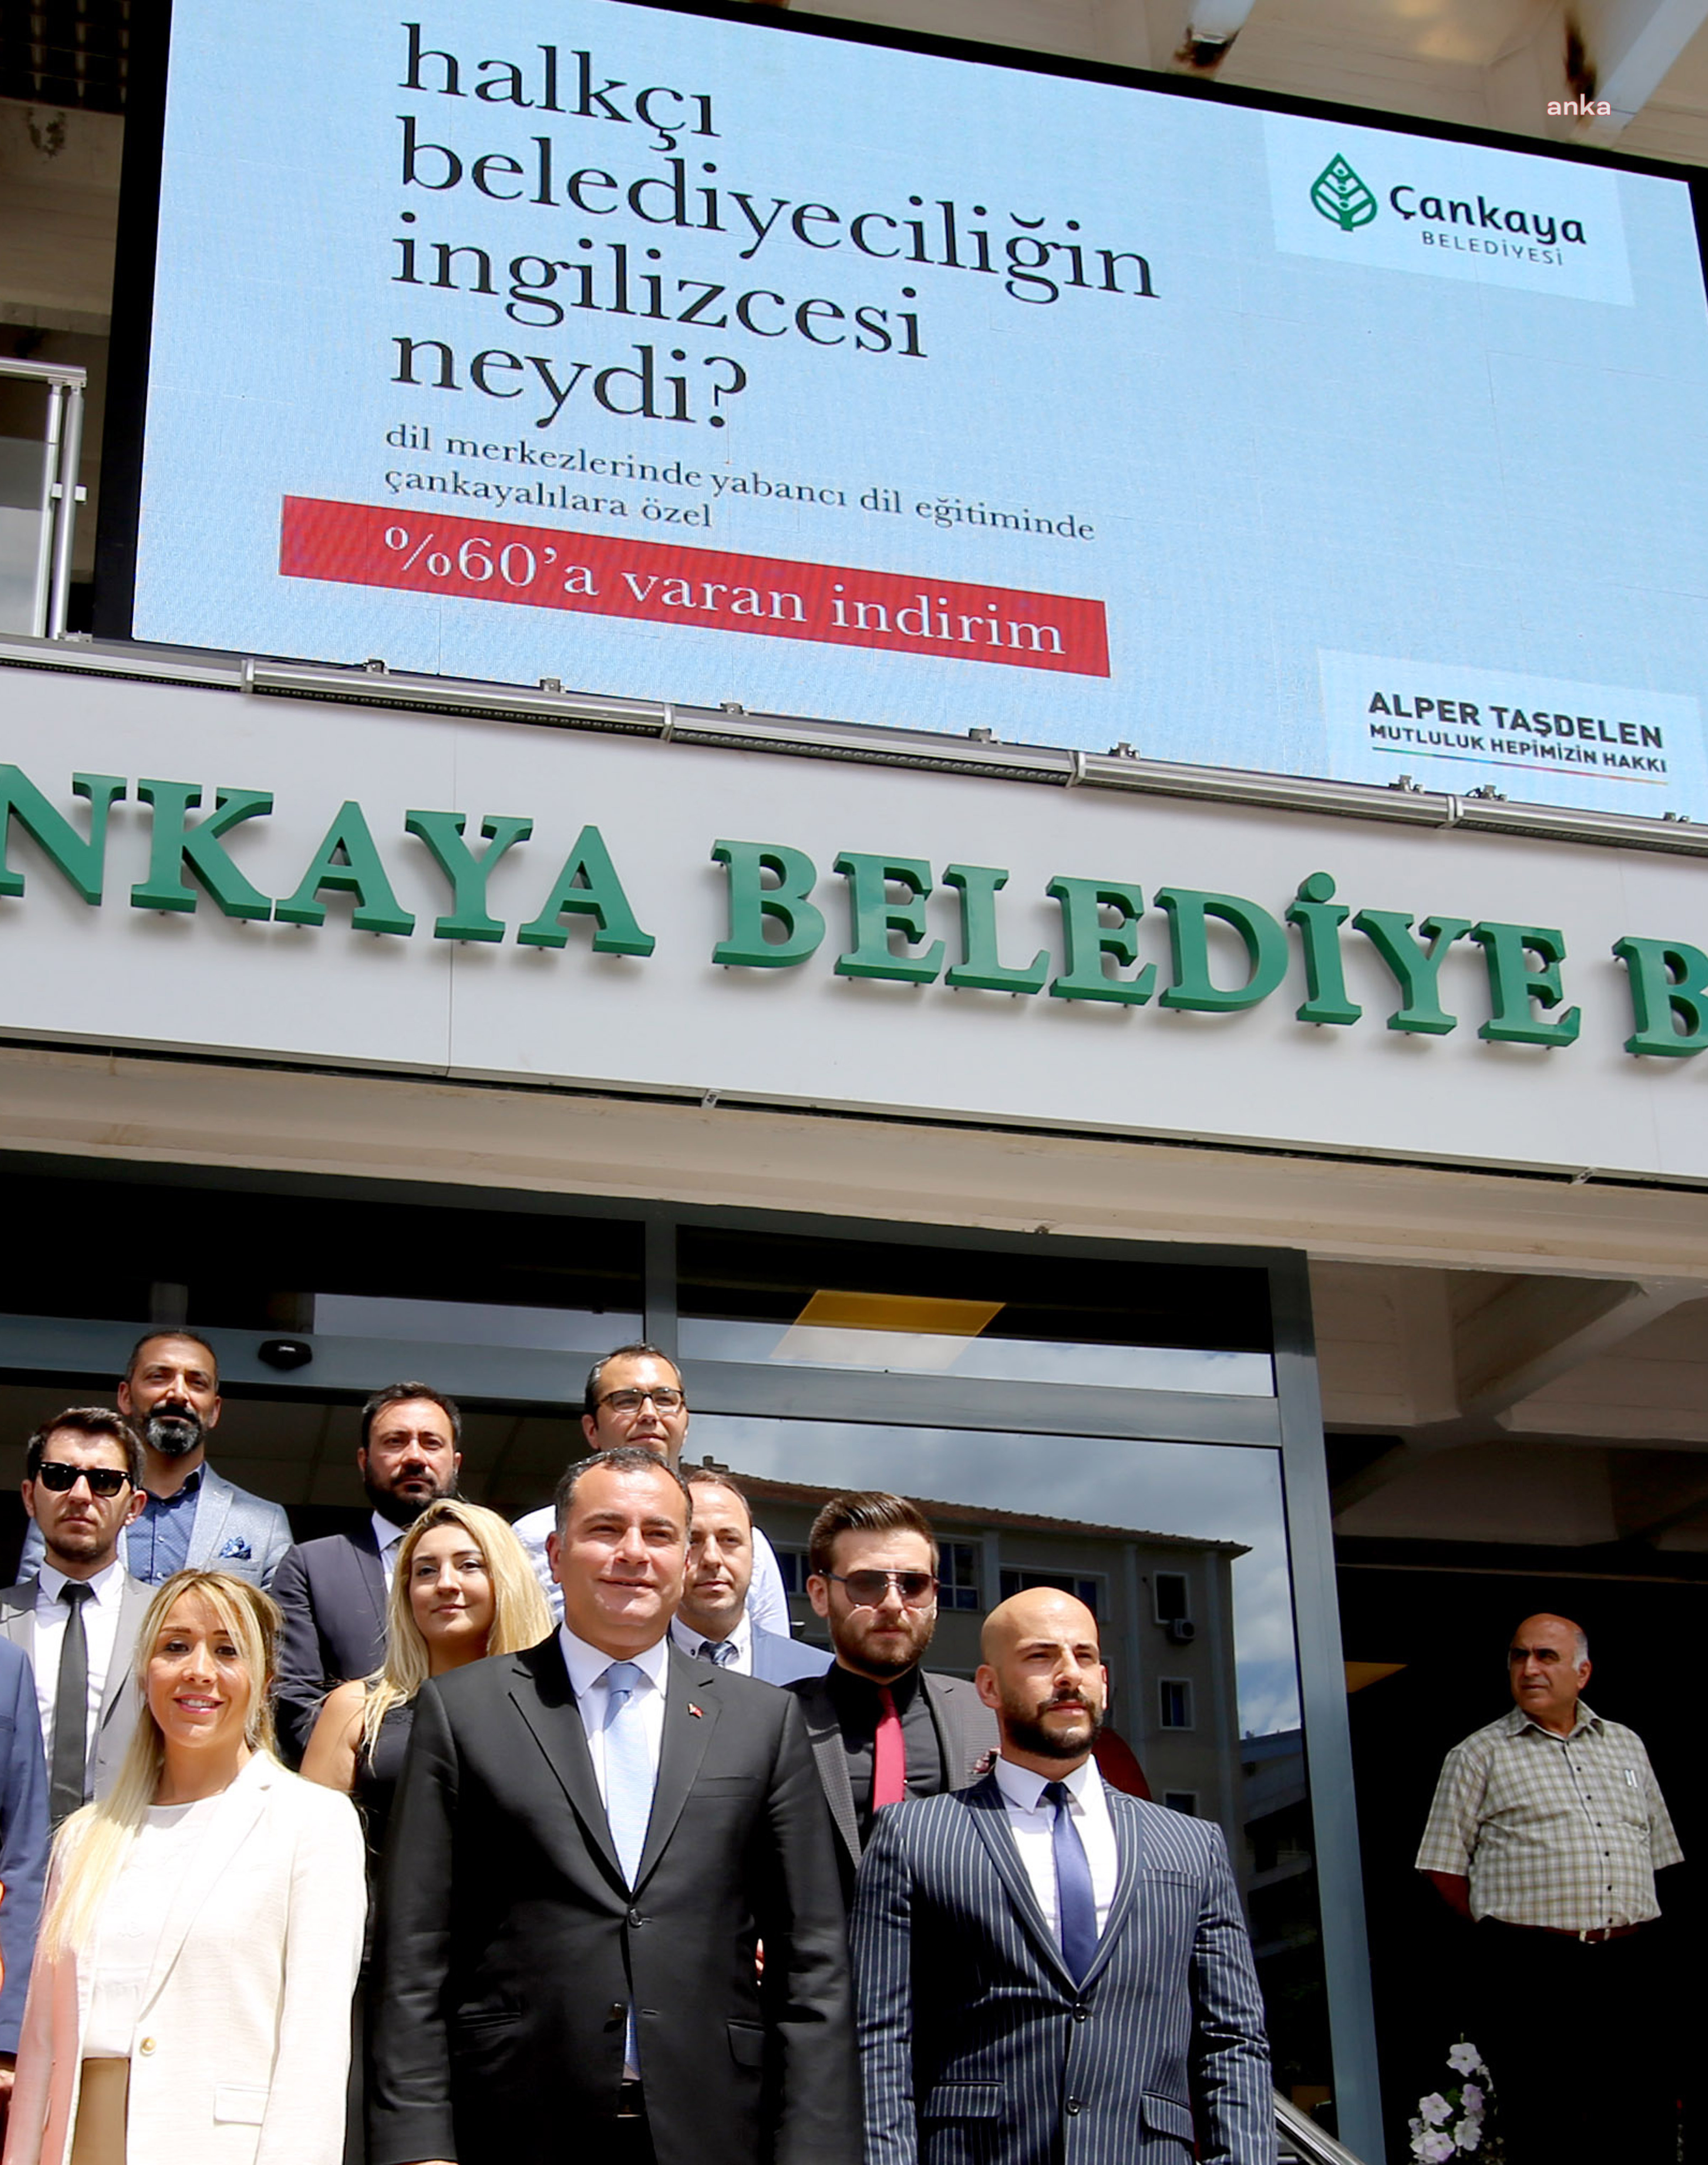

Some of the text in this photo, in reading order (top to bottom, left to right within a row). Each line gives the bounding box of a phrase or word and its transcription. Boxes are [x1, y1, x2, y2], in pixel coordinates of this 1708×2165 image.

[398, 22, 721, 151] halkçı
[396, 115, 1160, 304] belediyeciliğin
[1389, 185, 1587, 245] Çankaya
[1422, 230, 1563, 266] BELEDİYESİ
[390, 212, 928, 358] ingilizcesi
[390, 336, 747, 429] neydi?
[384, 469, 711, 527] çankayalılara özel
[386, 424, 1094, 540] dil merkezlerinde yabancı dil eğitiminde
[621, 572, 808, 622] varan
[831, 584, 1066, 655] indirim
[1369, 692, 1664, 749] ALPER TAŞDELEN
[1369, 724, 1667, 773] MUTLULUK HEPİMİZİN HAKKI
[712, 839, 1582, 1047] BELEDİYE
